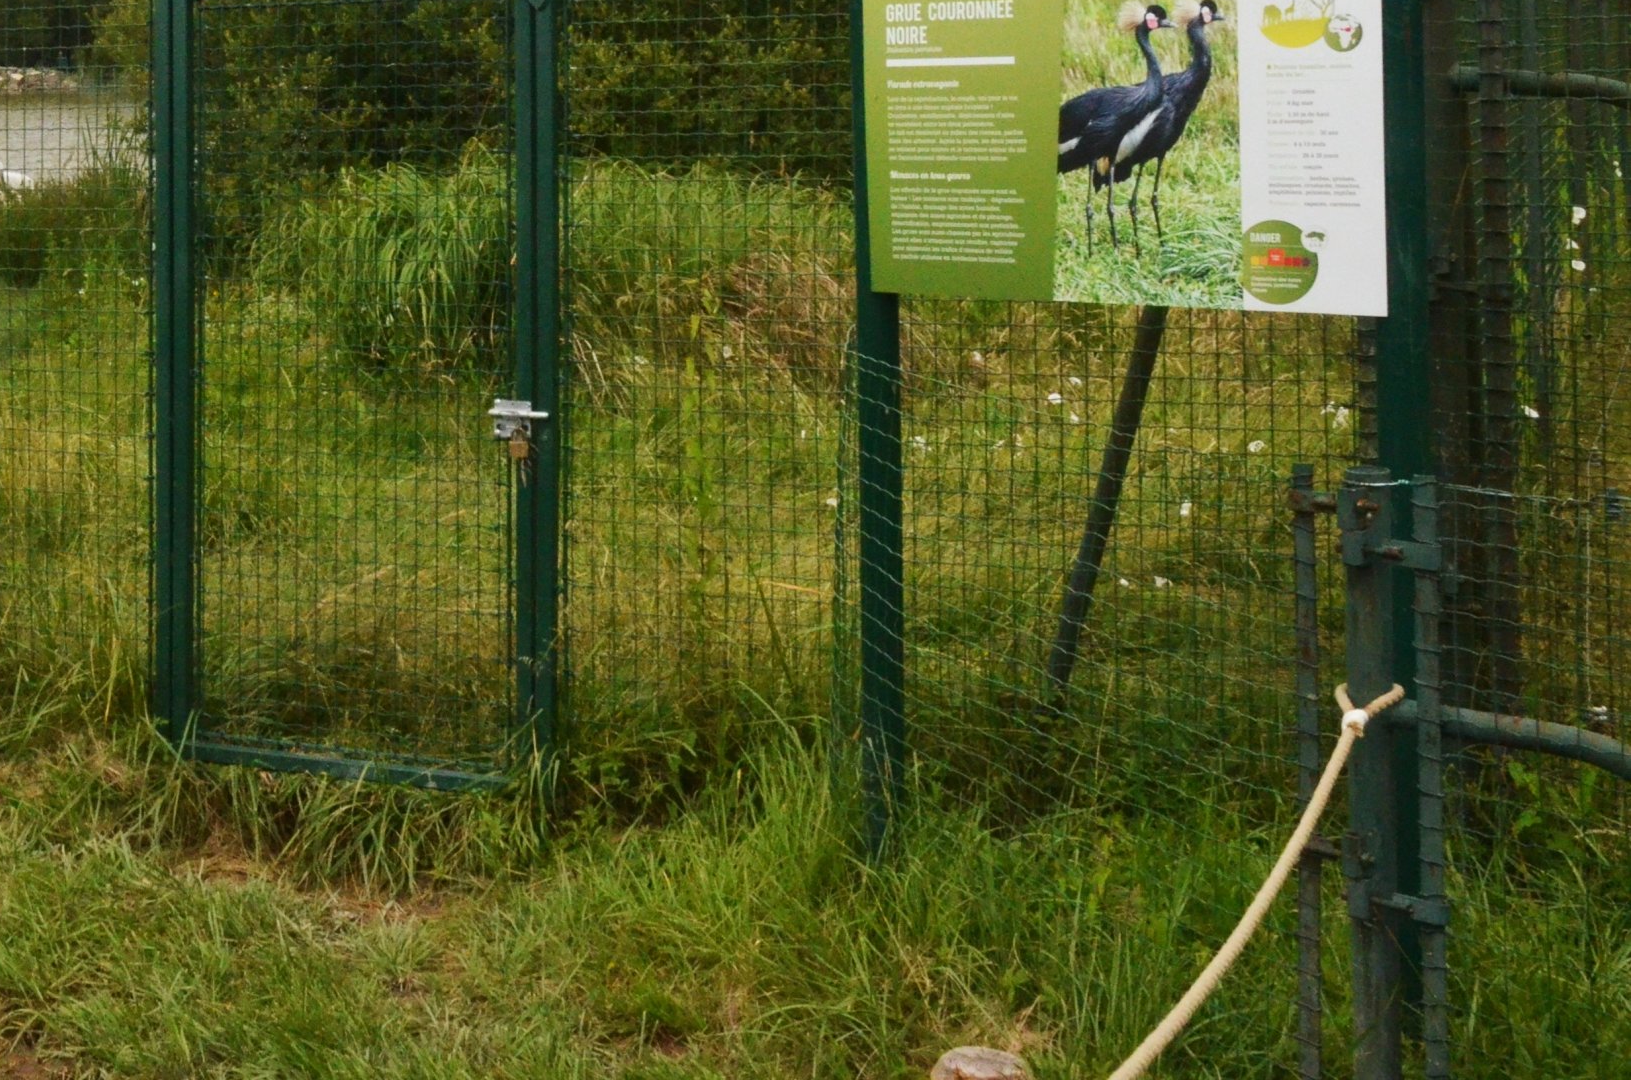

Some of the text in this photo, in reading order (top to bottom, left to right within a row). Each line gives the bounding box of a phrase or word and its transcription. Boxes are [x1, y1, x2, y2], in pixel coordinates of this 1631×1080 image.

[886, 3, 921, 22] GRUE
[886, 26, 928, 45] NOIRE
[1250, 232, 1281, 244] DANGER
